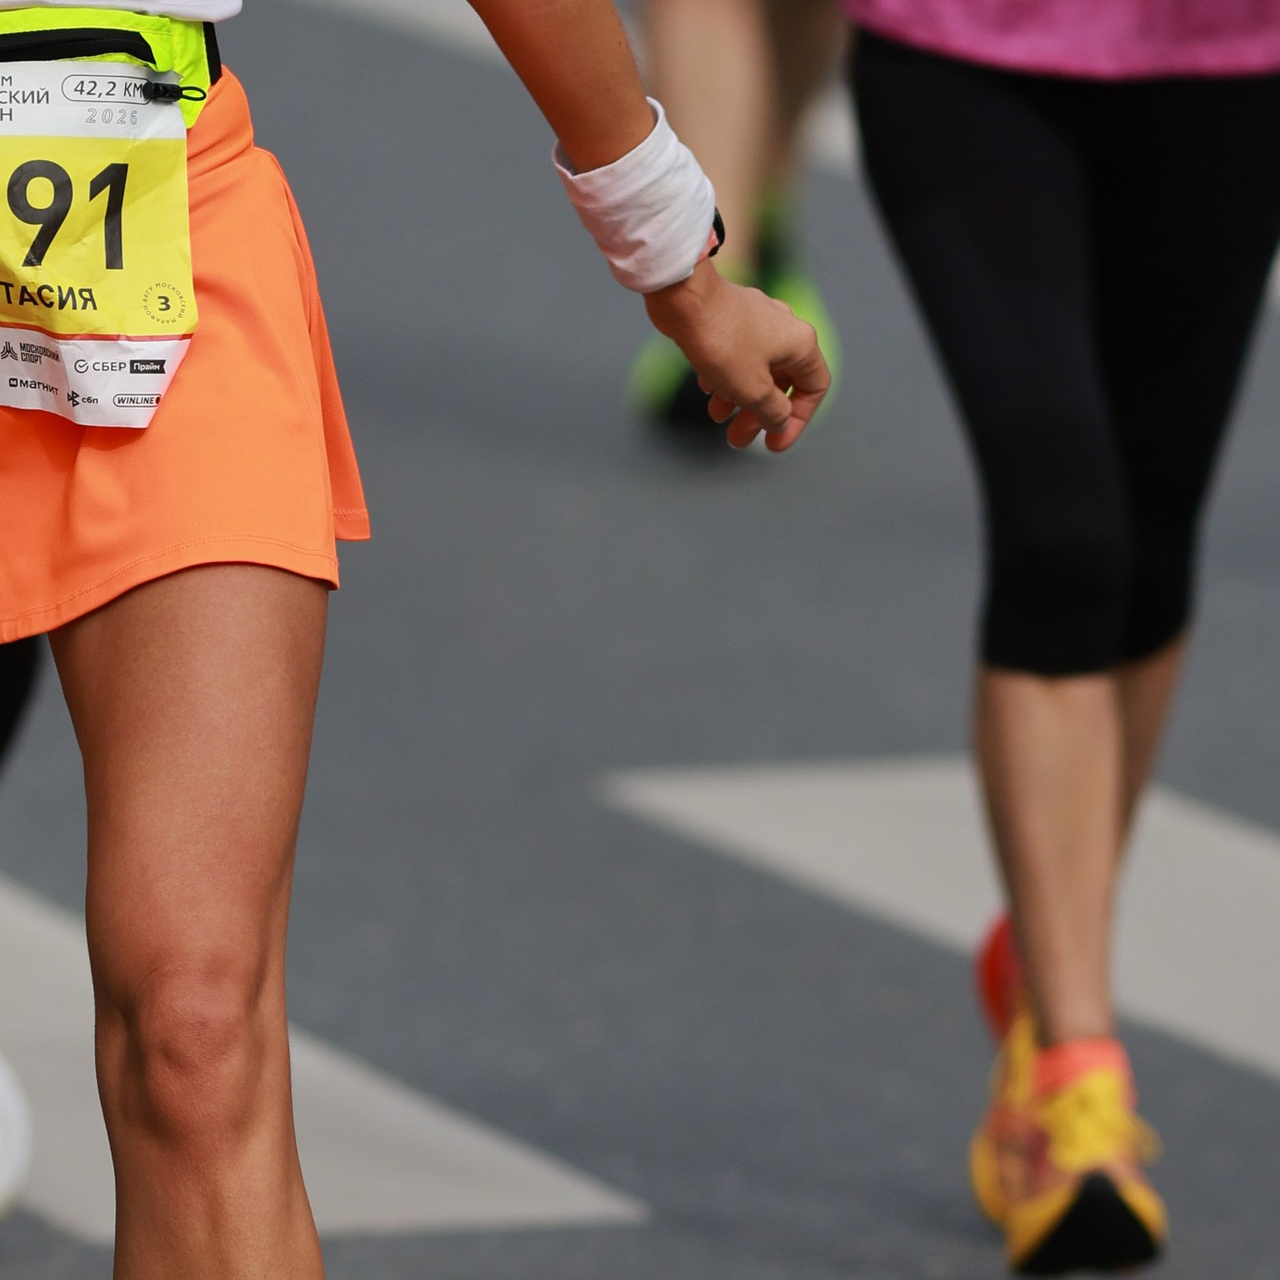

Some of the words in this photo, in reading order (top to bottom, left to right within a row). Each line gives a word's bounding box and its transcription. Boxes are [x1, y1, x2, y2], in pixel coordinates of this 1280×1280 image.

[73, 80, 117, 98] 42,2
[85, 107, 138, 125] 2026
[157, 295, 171, 312] 3
[19, 342, 61, 363] МОСКОВСКИЙ
[20, 352, 42, 365] СПОРТ
[92, 361, 127, 372] СБЕР
[133, 362, 161, 372] Прайм
[81, 396, 99, 404] сбп
[117, 396, 155, 405] WINLINE
